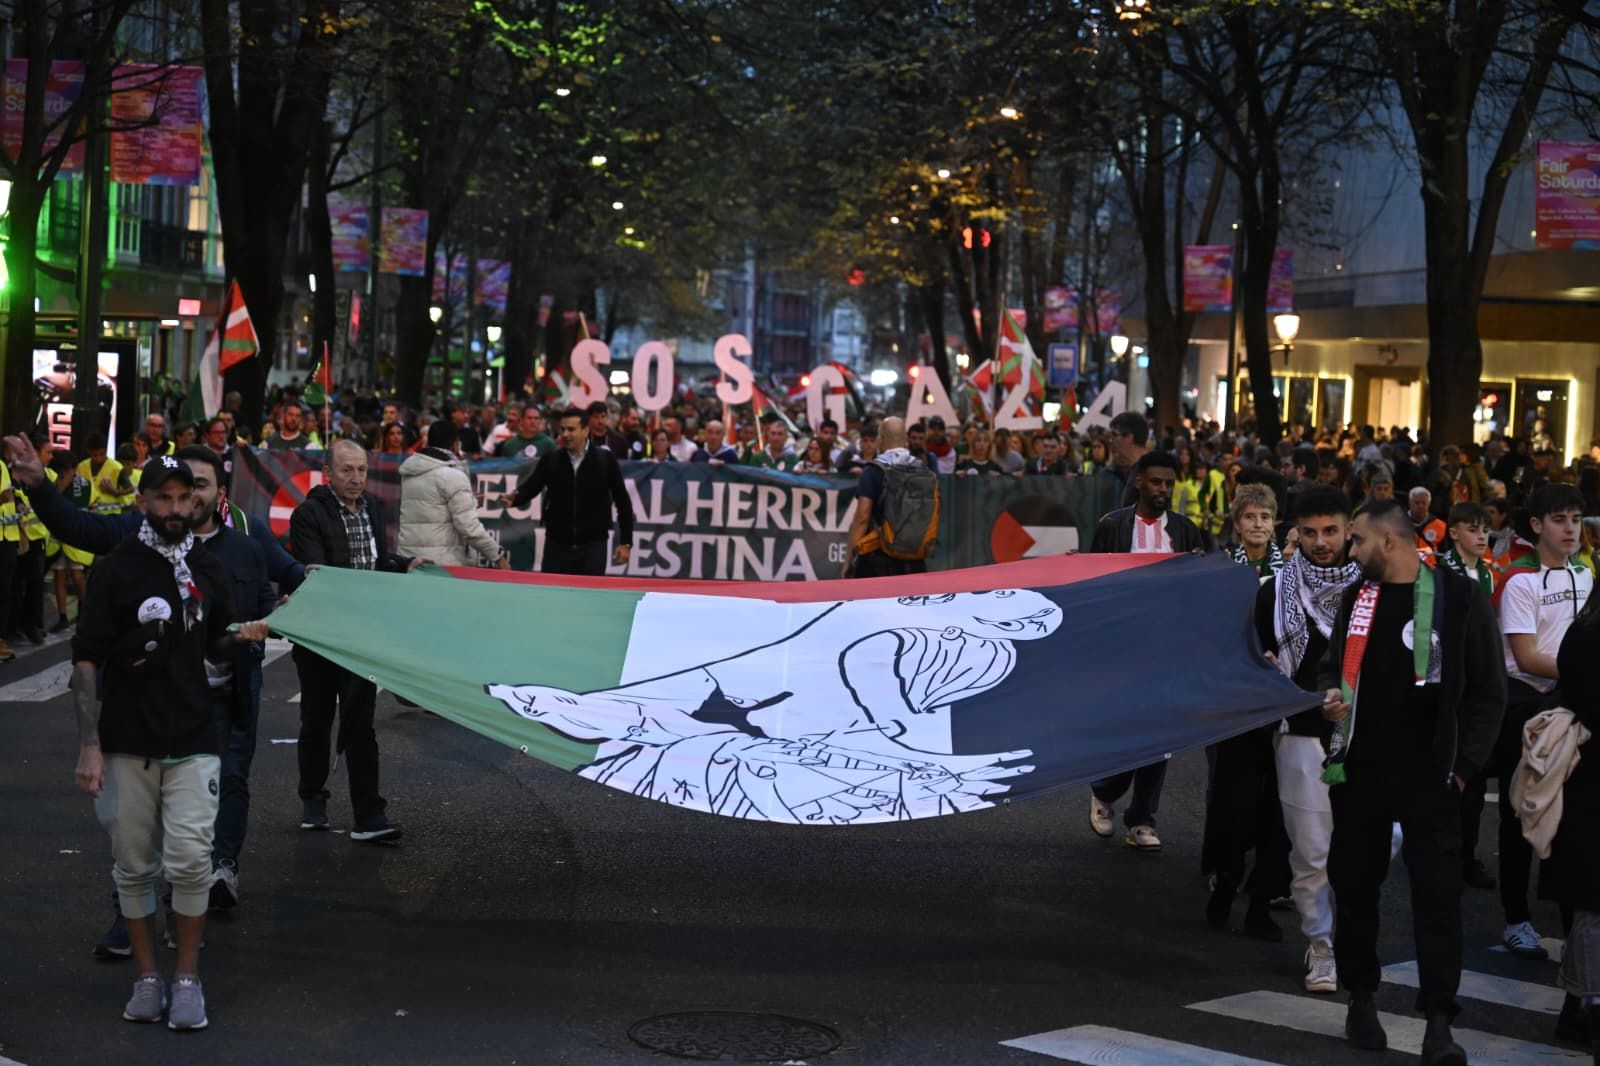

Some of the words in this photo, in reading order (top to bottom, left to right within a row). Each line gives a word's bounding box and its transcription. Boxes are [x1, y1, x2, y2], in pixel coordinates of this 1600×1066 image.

[1540, 157, 1570, 173] Fair
[1540, 173, 1600, 190] Saturd
[569, 333, 754, 411] SOS
[806, 364, 1127, 433] GAZA
